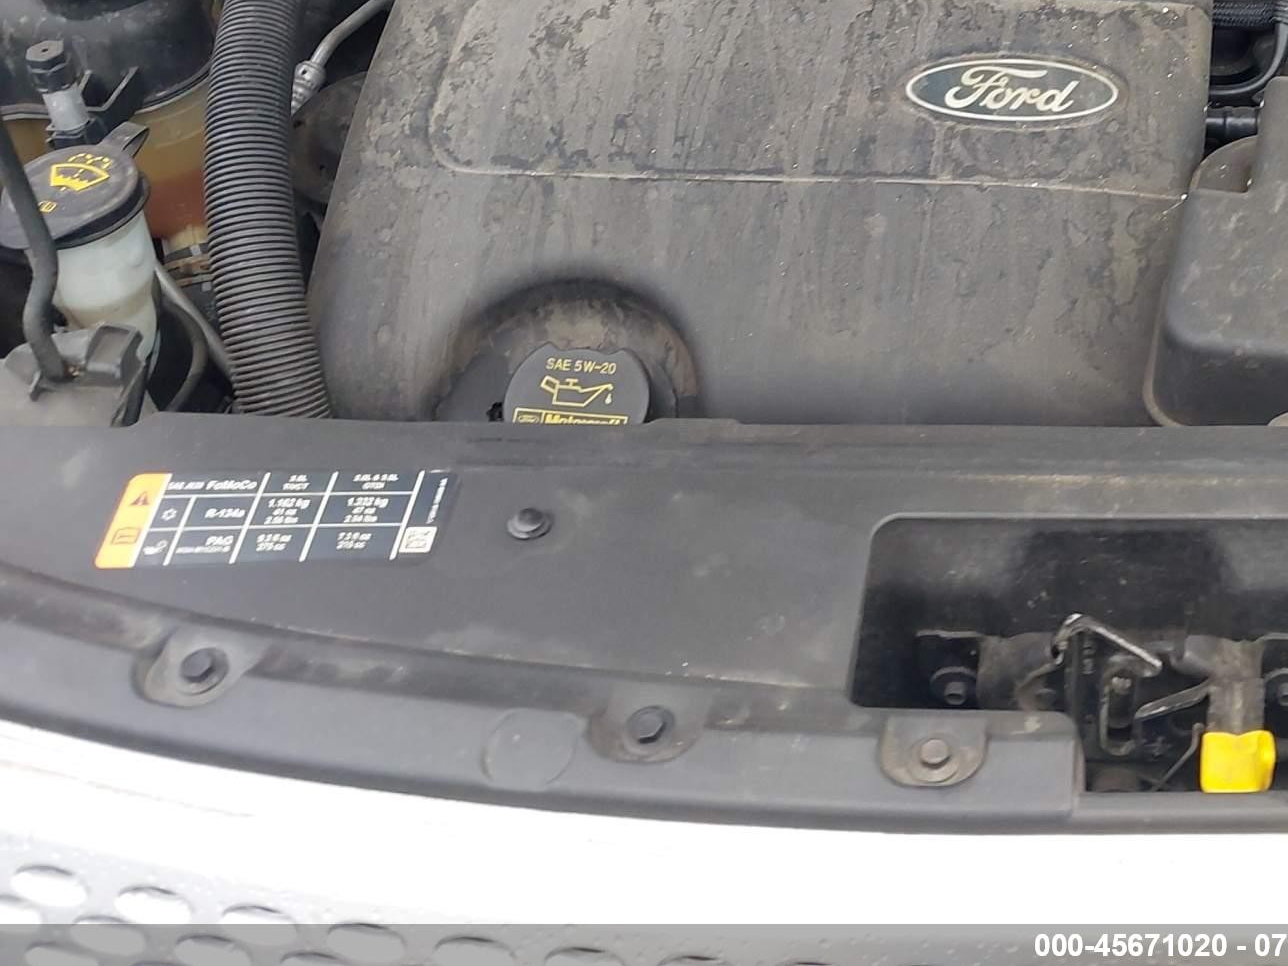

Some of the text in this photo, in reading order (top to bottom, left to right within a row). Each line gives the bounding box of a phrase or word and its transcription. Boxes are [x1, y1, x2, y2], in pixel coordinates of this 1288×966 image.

[944, 65, 1080, 113] Ford
[545, 357, 617, 375] SAE 5W-20
[205, 479, 258, 491] FoMoCo
